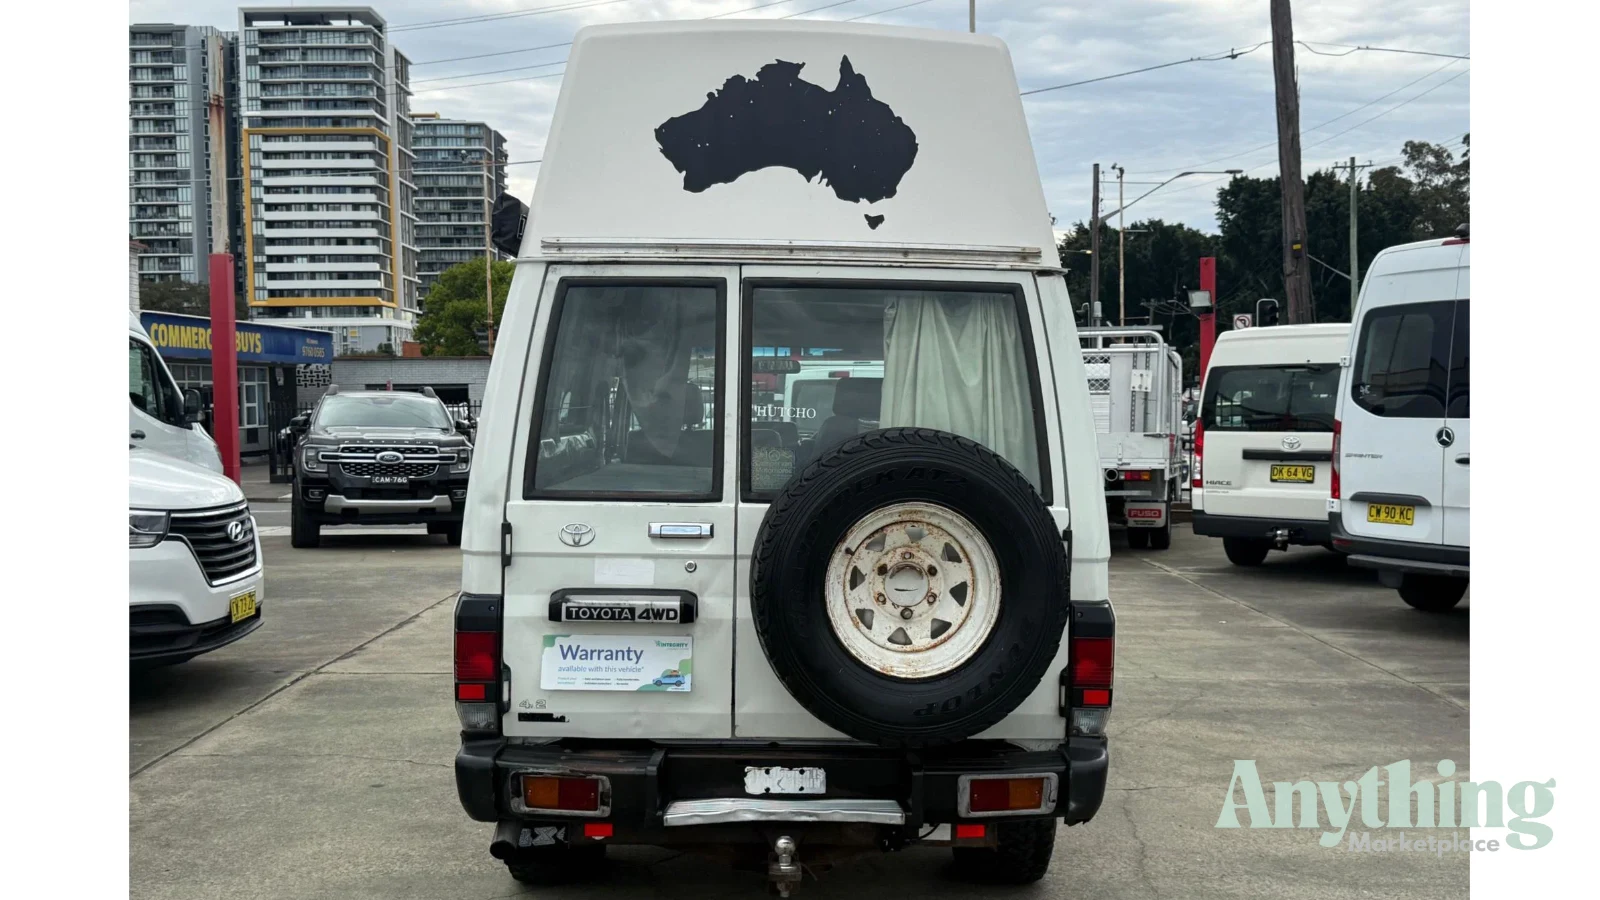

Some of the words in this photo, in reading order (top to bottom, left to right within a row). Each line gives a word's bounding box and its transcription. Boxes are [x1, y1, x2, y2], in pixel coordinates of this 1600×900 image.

[150, 323, 212, 350] COMMERC
[235, 331, 262, 354] BUYS
[756, 405, 817, 419] HUTCHO
[569, 607, 632, 619] TOYOTA
[637, 607, 679, 621] 4WD
[559, 644, 644, 665] Warranty
